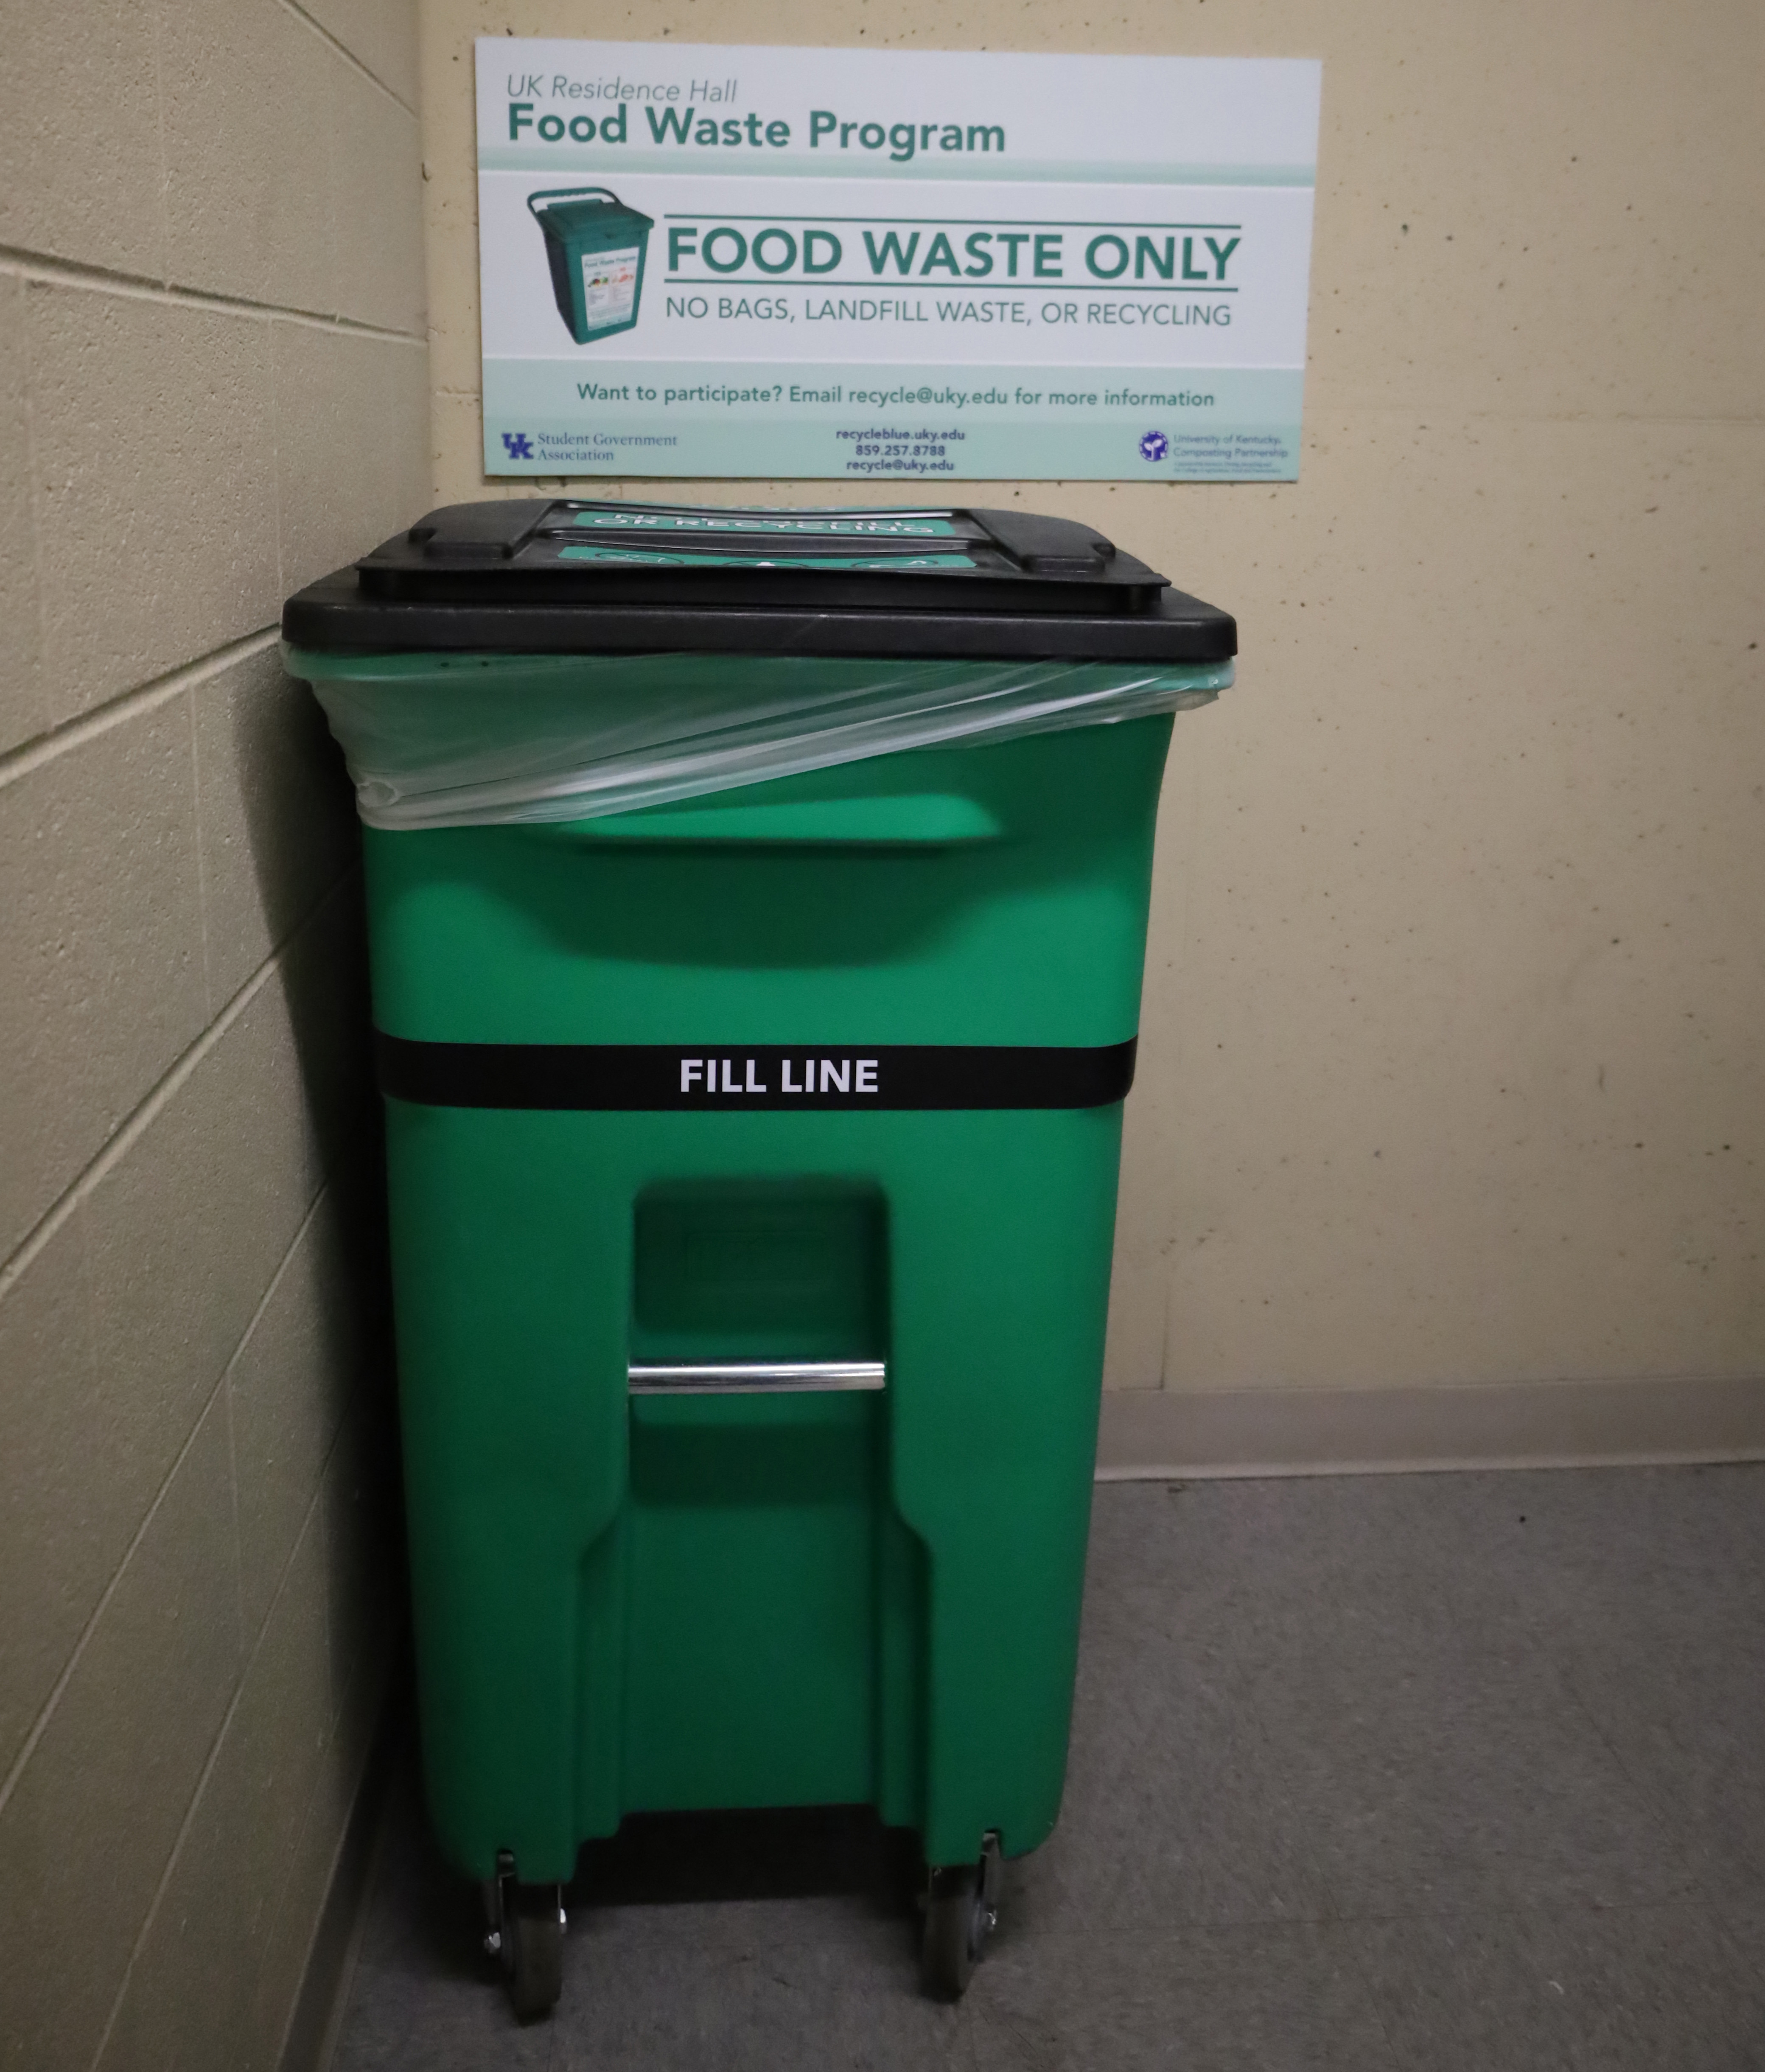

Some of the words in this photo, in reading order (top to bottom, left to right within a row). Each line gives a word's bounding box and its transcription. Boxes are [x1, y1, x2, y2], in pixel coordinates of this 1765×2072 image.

[507, 73, 544, 98] UK
[552, 76, 681, 101] Residence
[689, 79, 738, 103] Hall
[509, 103, 628, 143] Food
[644, 106, 791, 147] Waste
[810, 110, 1006, 162] Program
[668, 227, 842, 274] FOOD
[862, 231, 1064, 277] WASTE
[1084, 234, 1241, 280] ONLY
[667, 297, 708, 319] NO
[718, 298, 796, 323] BAGS,
[805, 300, 929, 321] LANDFILL
[936, 301, 1032, 326] WASTE,
[1041, 303, 1079, 325] OR
[1087, 304, 1232, 326] RECYCLING
[577, 384, 630, 400] Want
[636, 385, 657, 400] to
[664, 386, 782, 405] participate?
[790, 386, 842, 403] Email
[849, 387, 1008, 408] recycle@uky.edu
[1014, 388, 1043, 404] for
[1048, 392, 1098, 405] more
[1104, 388, 1215, 406] information
[538, 432, 589, 445] Student
[594, 434, 677, 446] Government
[835, 428, 965, 443] recycleblue.uky.edu
[1174, 435, 1219, 445] University
[1223, 435, 1233, 444] of
[501, 433, 534, 459] UK
[538, 448, 614, 461] Association
[855, 445, 946, 456] 859.257.8788
[1173, 448, 1232, 458] Composting
[1235, 449, 1288, 459] Partnership
[846, 459, 955, 473] recycle@uky.edu
[681, 1059, 767, 1092] FILL
[781, 1059, 878, 1092] LINE
